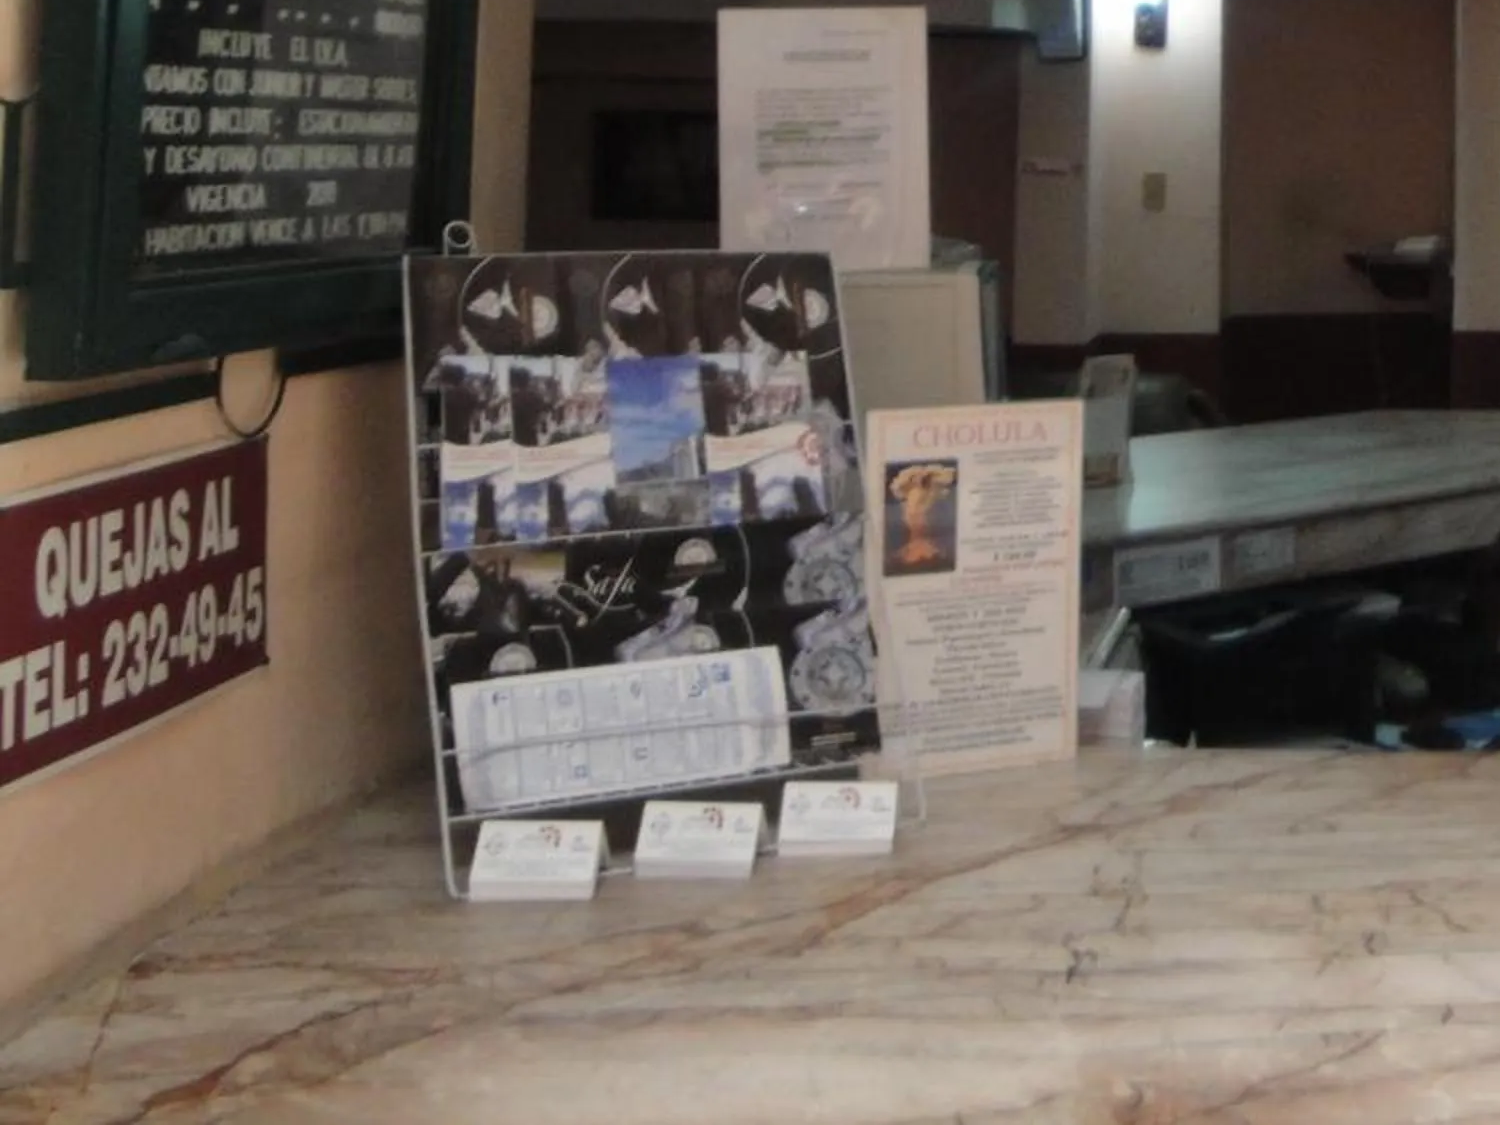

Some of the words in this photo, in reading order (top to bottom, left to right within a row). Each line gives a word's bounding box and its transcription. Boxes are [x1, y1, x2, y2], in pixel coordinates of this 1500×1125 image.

[912, 420, 1049, 450] CHOLULA
[35, 487, 192, 618] QUEJAS
[198, 476, 240, 561] AL
[0, 640, 91, 751] TEL:
[101, 566, 263, 708] 232-49-45
